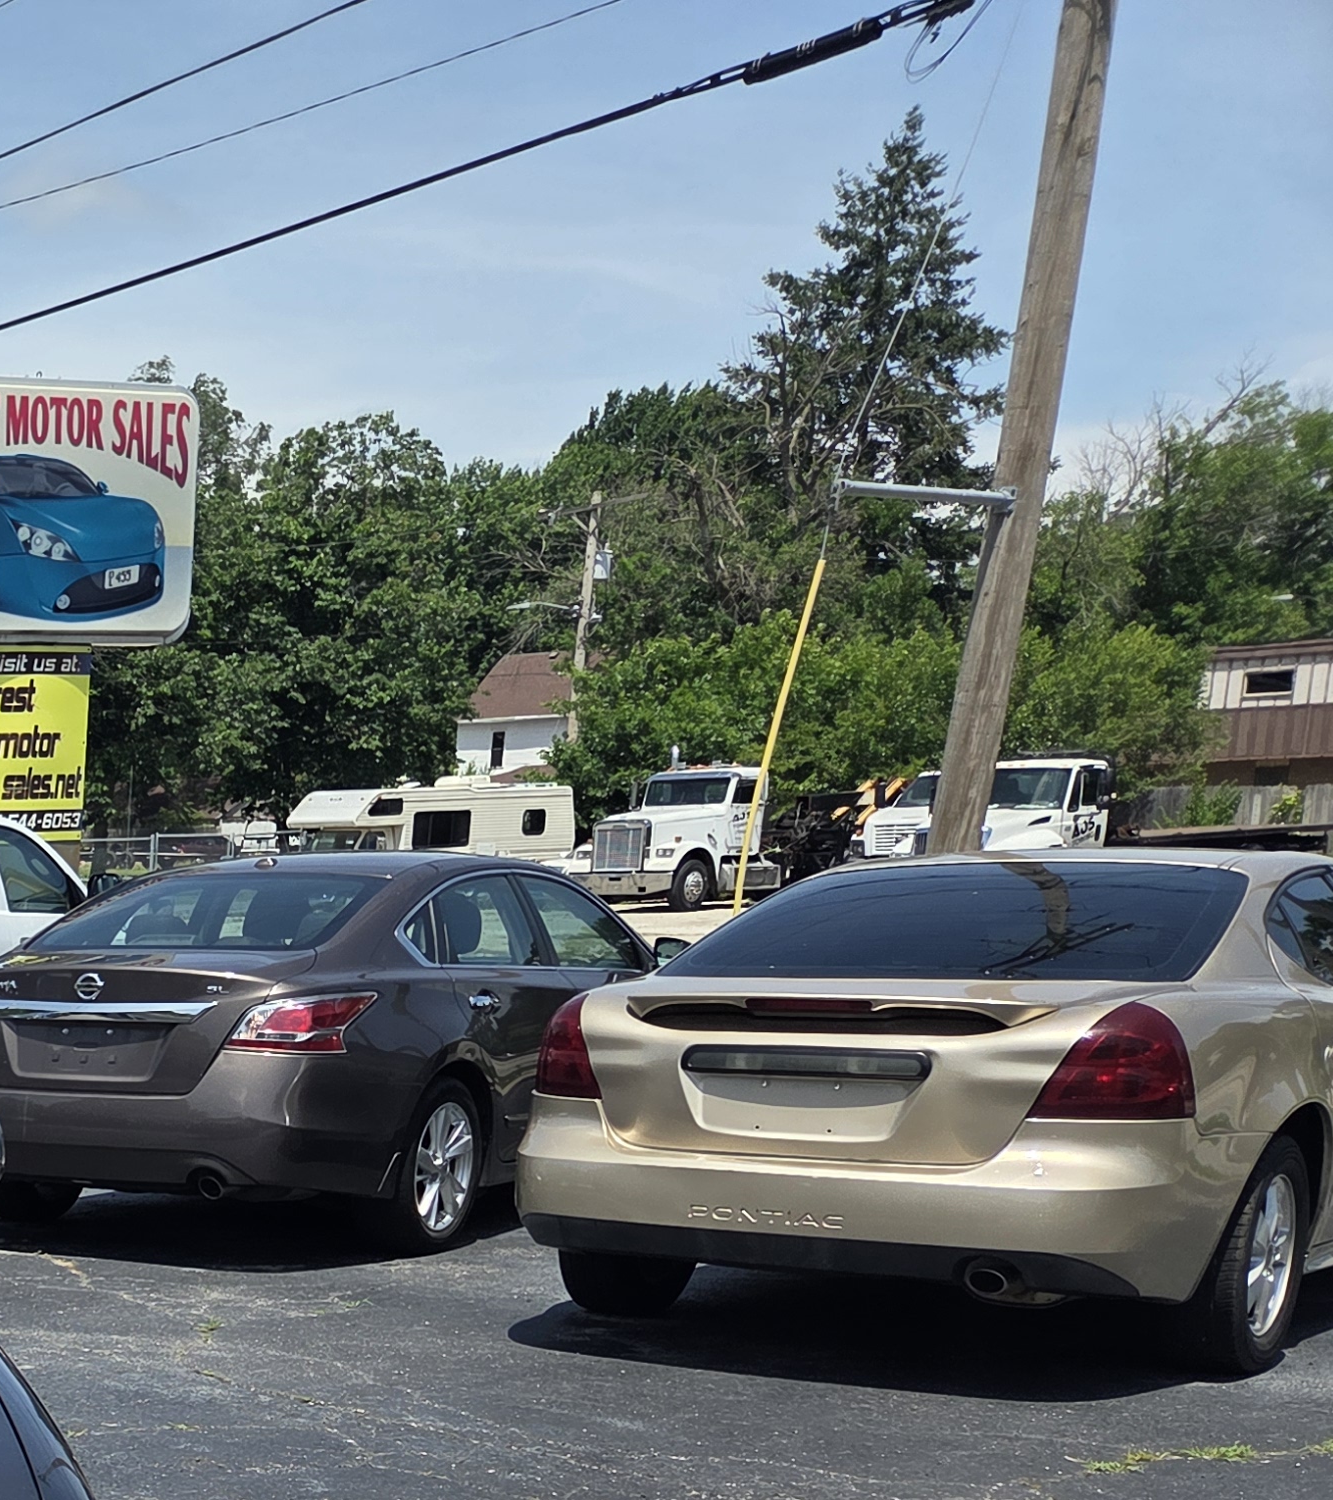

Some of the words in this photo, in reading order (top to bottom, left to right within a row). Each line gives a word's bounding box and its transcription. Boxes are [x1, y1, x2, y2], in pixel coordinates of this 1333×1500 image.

[6, 395, 104, 451] MOTOR
[111, 399, 191, 489] SALES
[32, 658, 57, 672] us
[60, 654, 82, 672] at:
[1, 766, 82, 800] sales.net
[206, 984, 230, 994] SL
[687, 1204, 844, 1230] PONTIAC
